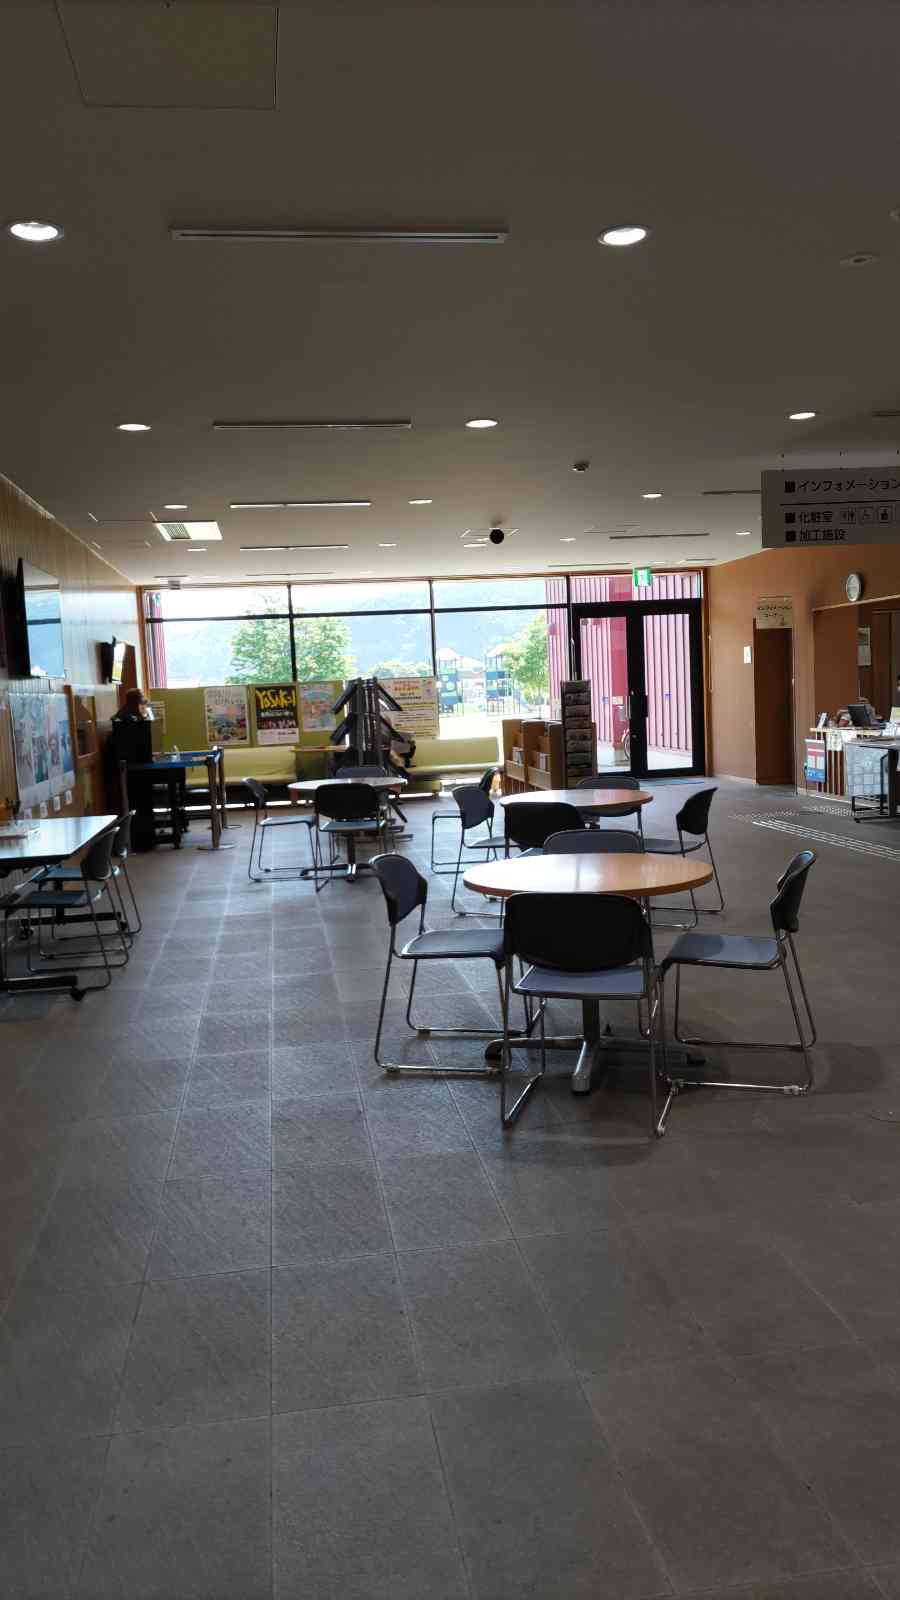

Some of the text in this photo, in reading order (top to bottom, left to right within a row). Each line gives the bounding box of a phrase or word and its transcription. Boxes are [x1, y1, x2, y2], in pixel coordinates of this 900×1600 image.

[799, 479, 900, 492] インフォメーション
[799, 512, 832, 524] 化粧室
[800, 529, 847, 542] 加工施設
